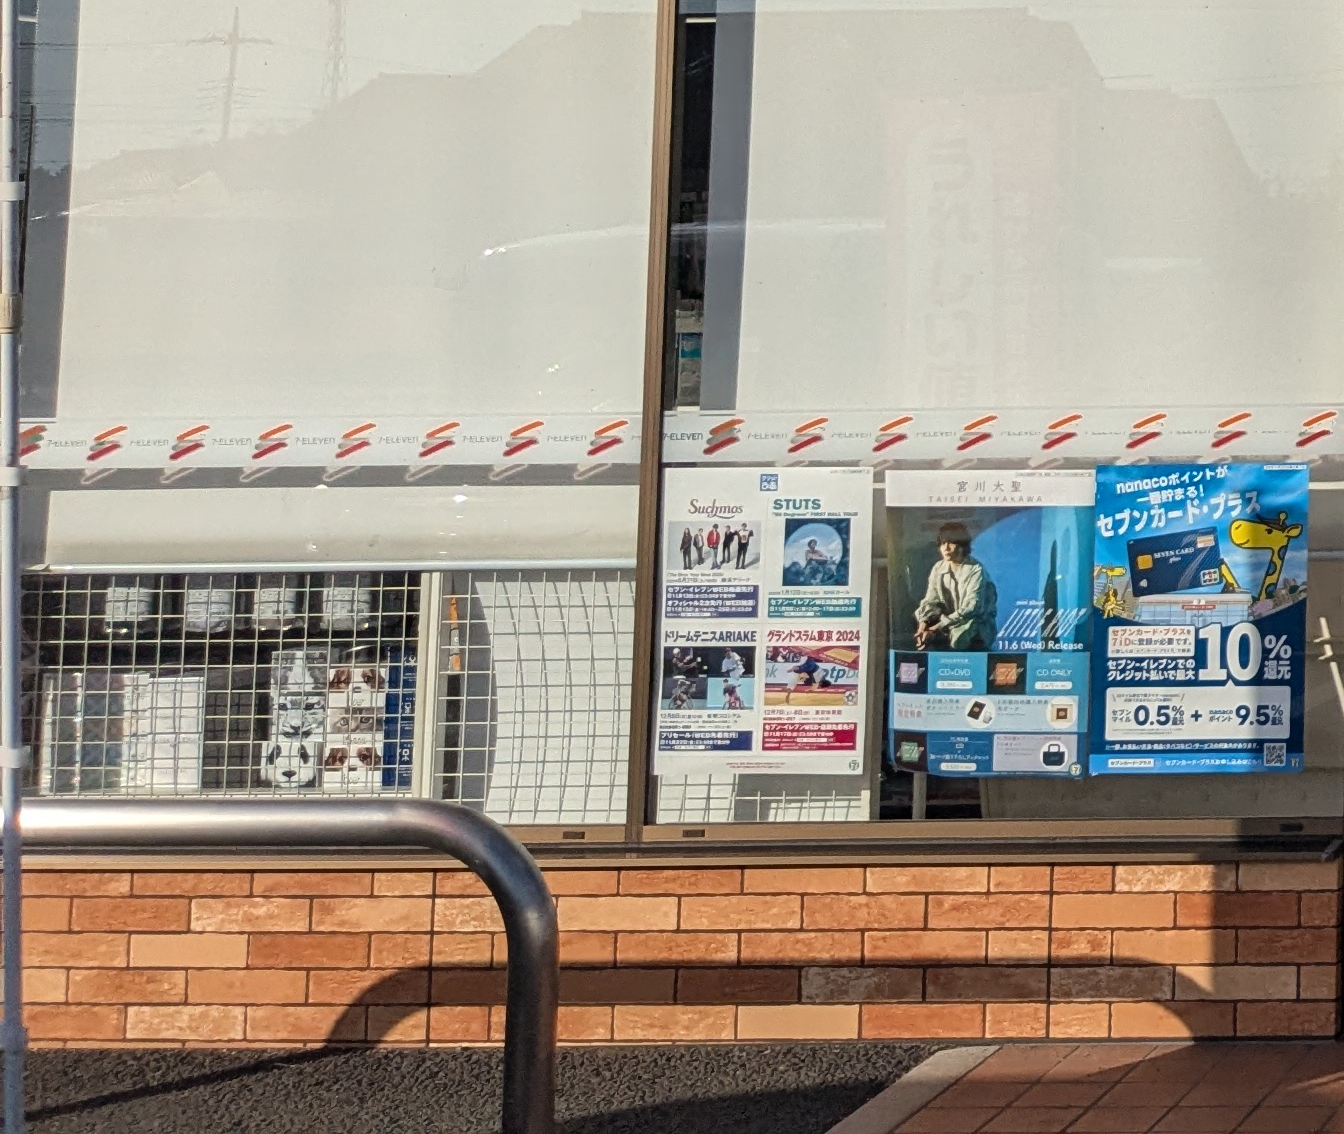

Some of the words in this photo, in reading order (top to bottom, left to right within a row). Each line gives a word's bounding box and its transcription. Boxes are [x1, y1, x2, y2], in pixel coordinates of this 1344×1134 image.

[1116, 465, 1228, 494] nanacoポイントが
[957, 480, 1023, 493] 宮川大聖
[688, 499, 744, 519] Suchmos
[773, 499, 822, 511] STUTS
[1097, 491, 1261, 537] セブンカード・プラス
[665, 630, 758, 643] ドリームテニスARIAKE
[836, 630, 861, 642] 2024
[998, 640, 1018, 650] 11.6
[1047, 640, 1084, 650] Release
